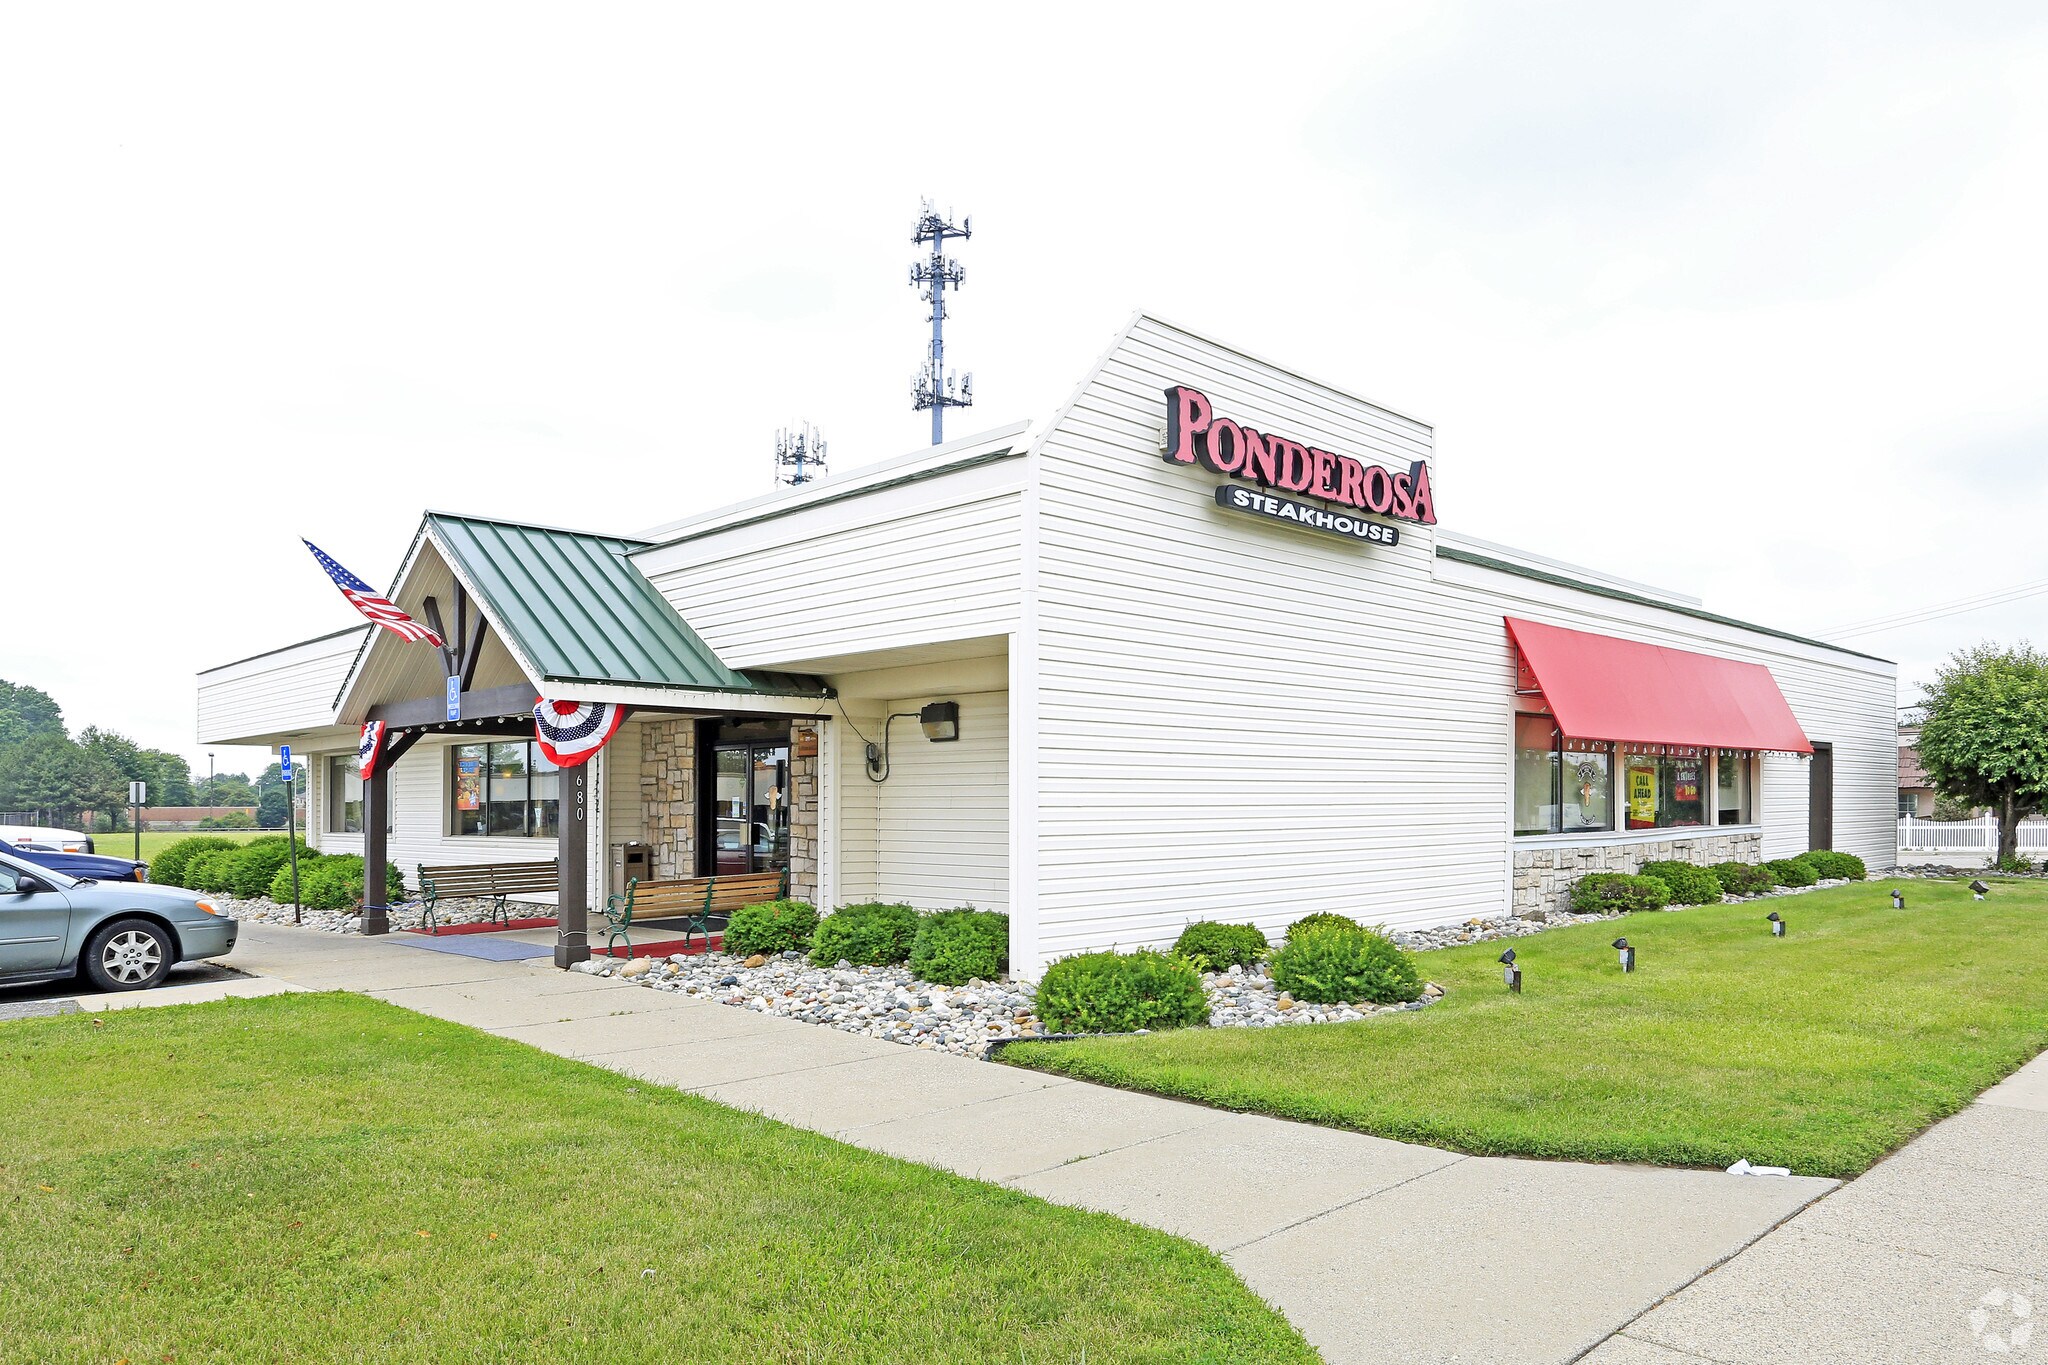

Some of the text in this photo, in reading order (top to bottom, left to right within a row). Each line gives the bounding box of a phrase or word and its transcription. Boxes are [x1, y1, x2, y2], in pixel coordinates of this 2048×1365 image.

[1164, 385, 1437, 525] PONDEROSA
[1233, 489, 1394, 544] STEAKHOUSE
[576, 774, 584, 821] 680
[1633, 788, 1652, 799] AHEAD
[1635, 775, 1650, 787] CALL
